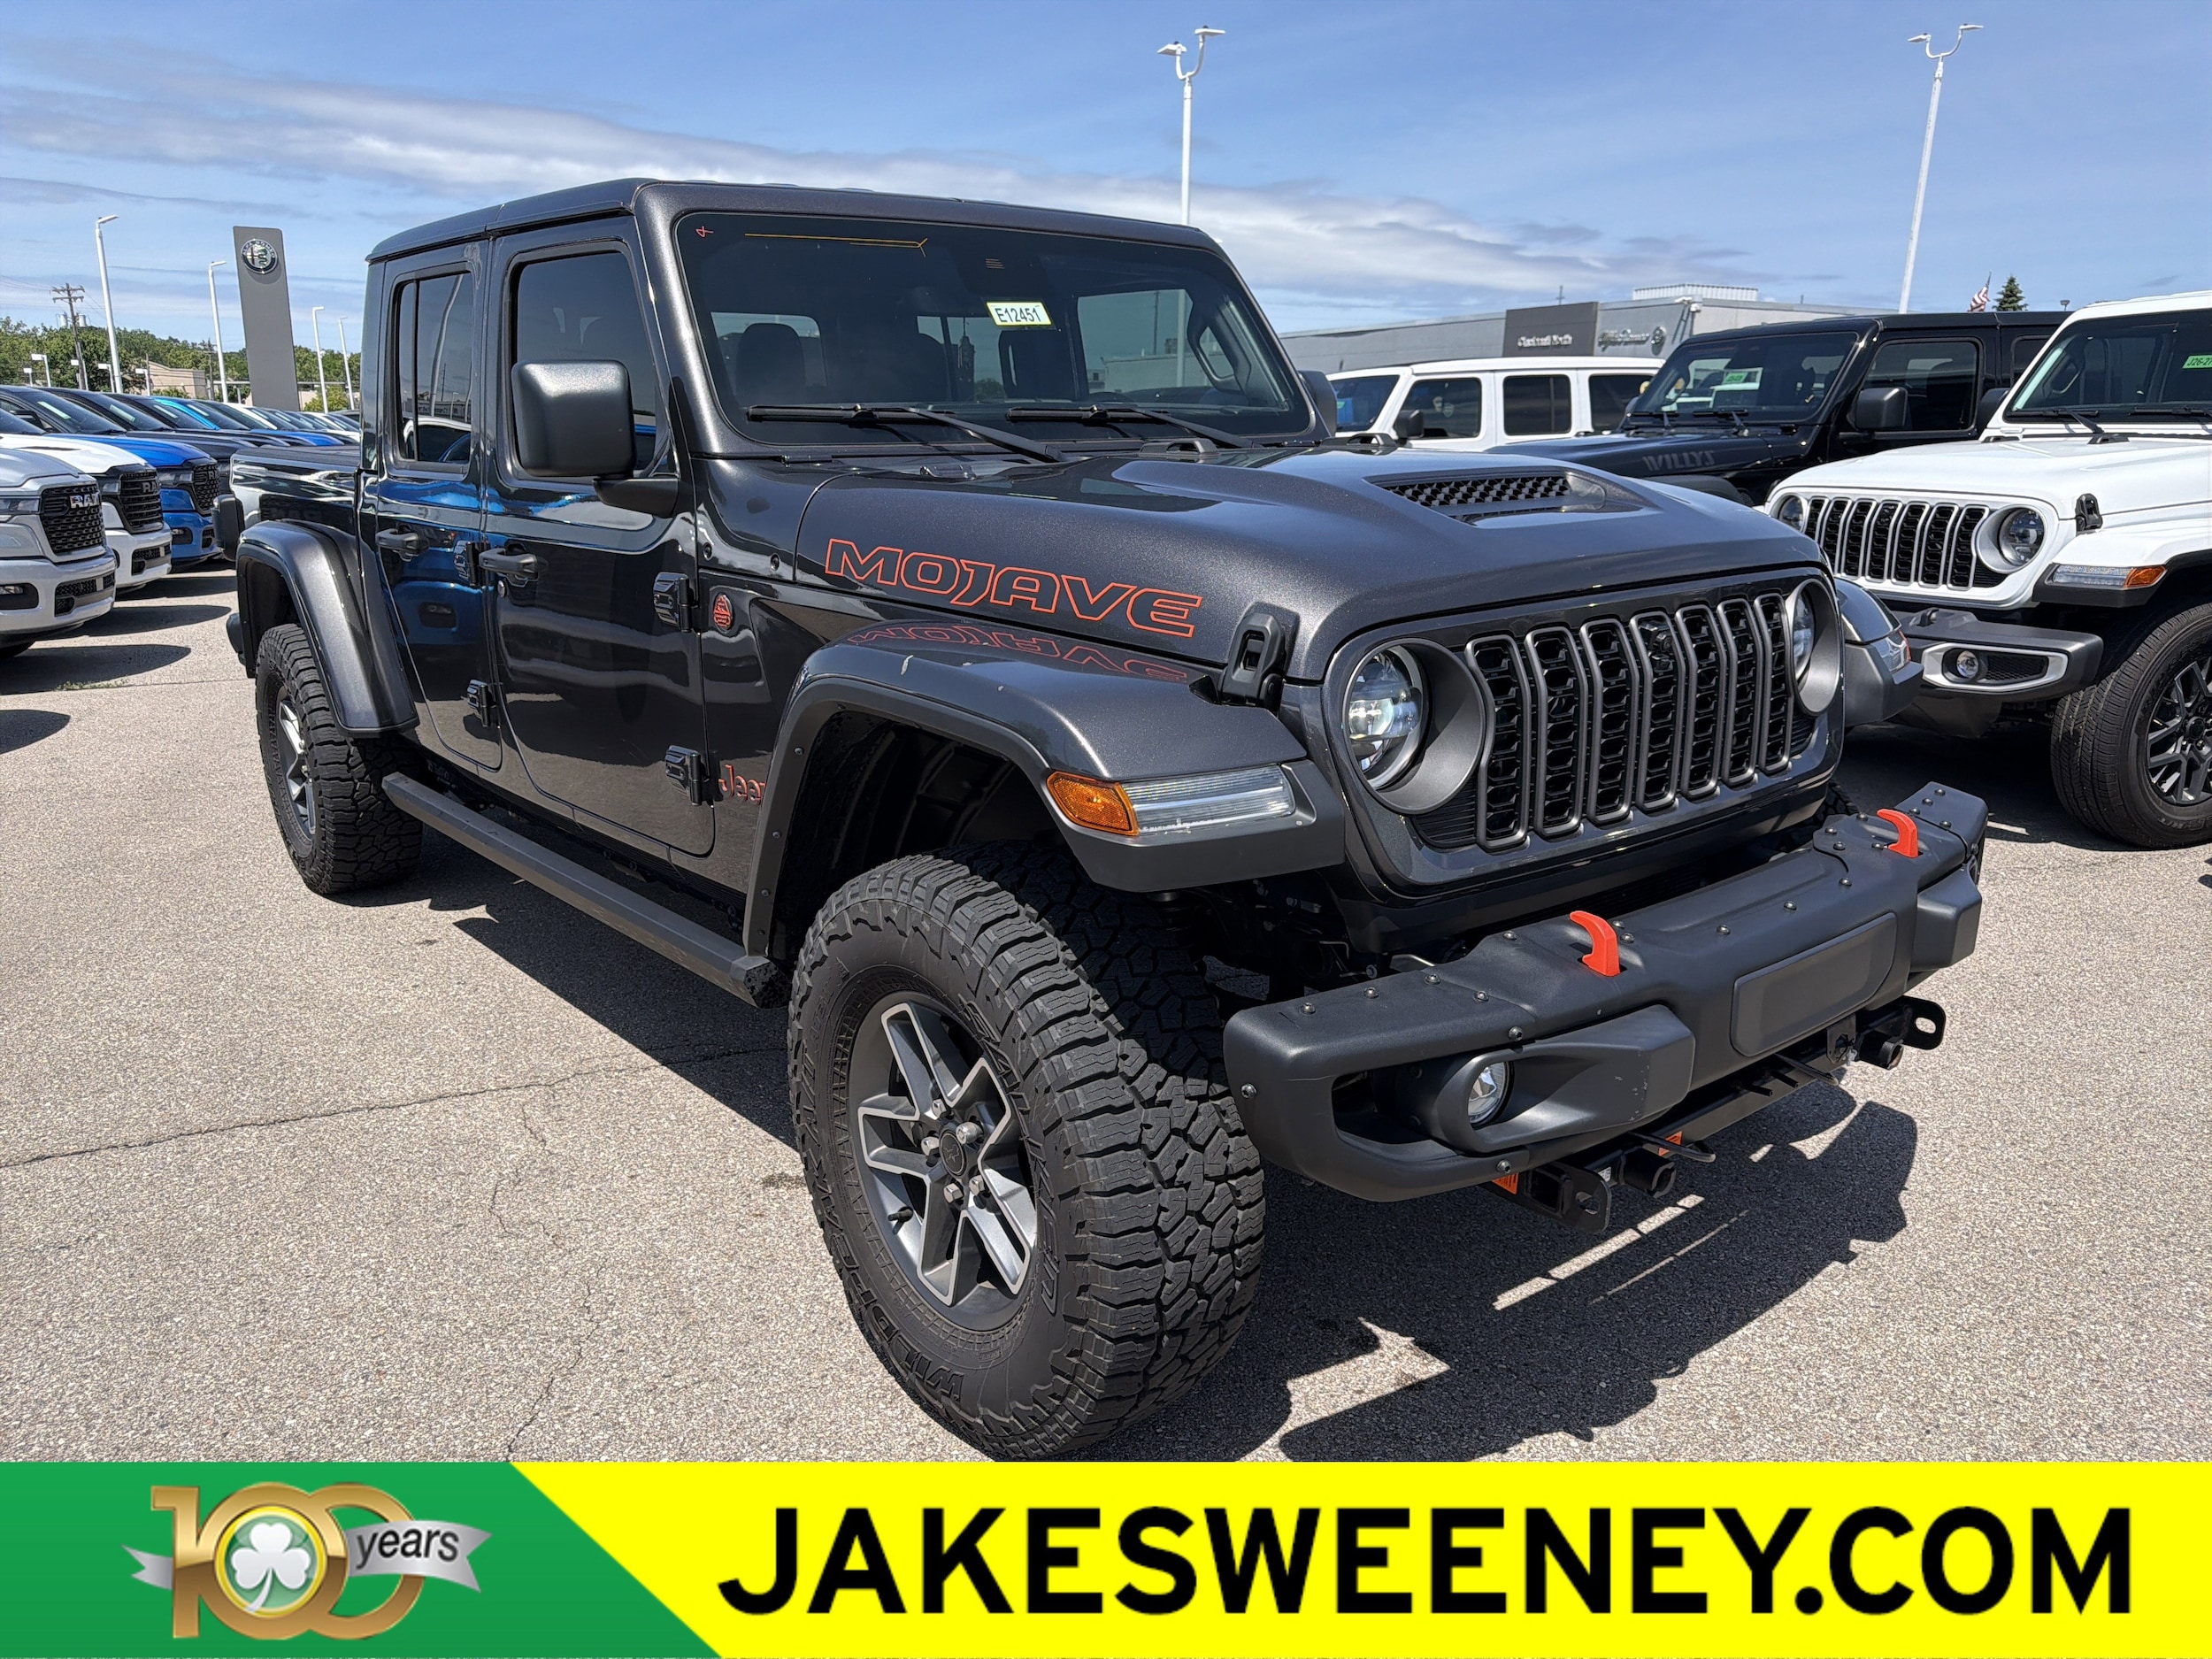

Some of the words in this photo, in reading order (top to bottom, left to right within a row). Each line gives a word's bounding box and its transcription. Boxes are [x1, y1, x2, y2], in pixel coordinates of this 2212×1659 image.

[995, 307, 1041, 322] E12451
[1642, 449, 1716, 472] WILLYS
[825, 539, 1202, 638] MOJAVE
[718, 764, 766, 805] Jee
